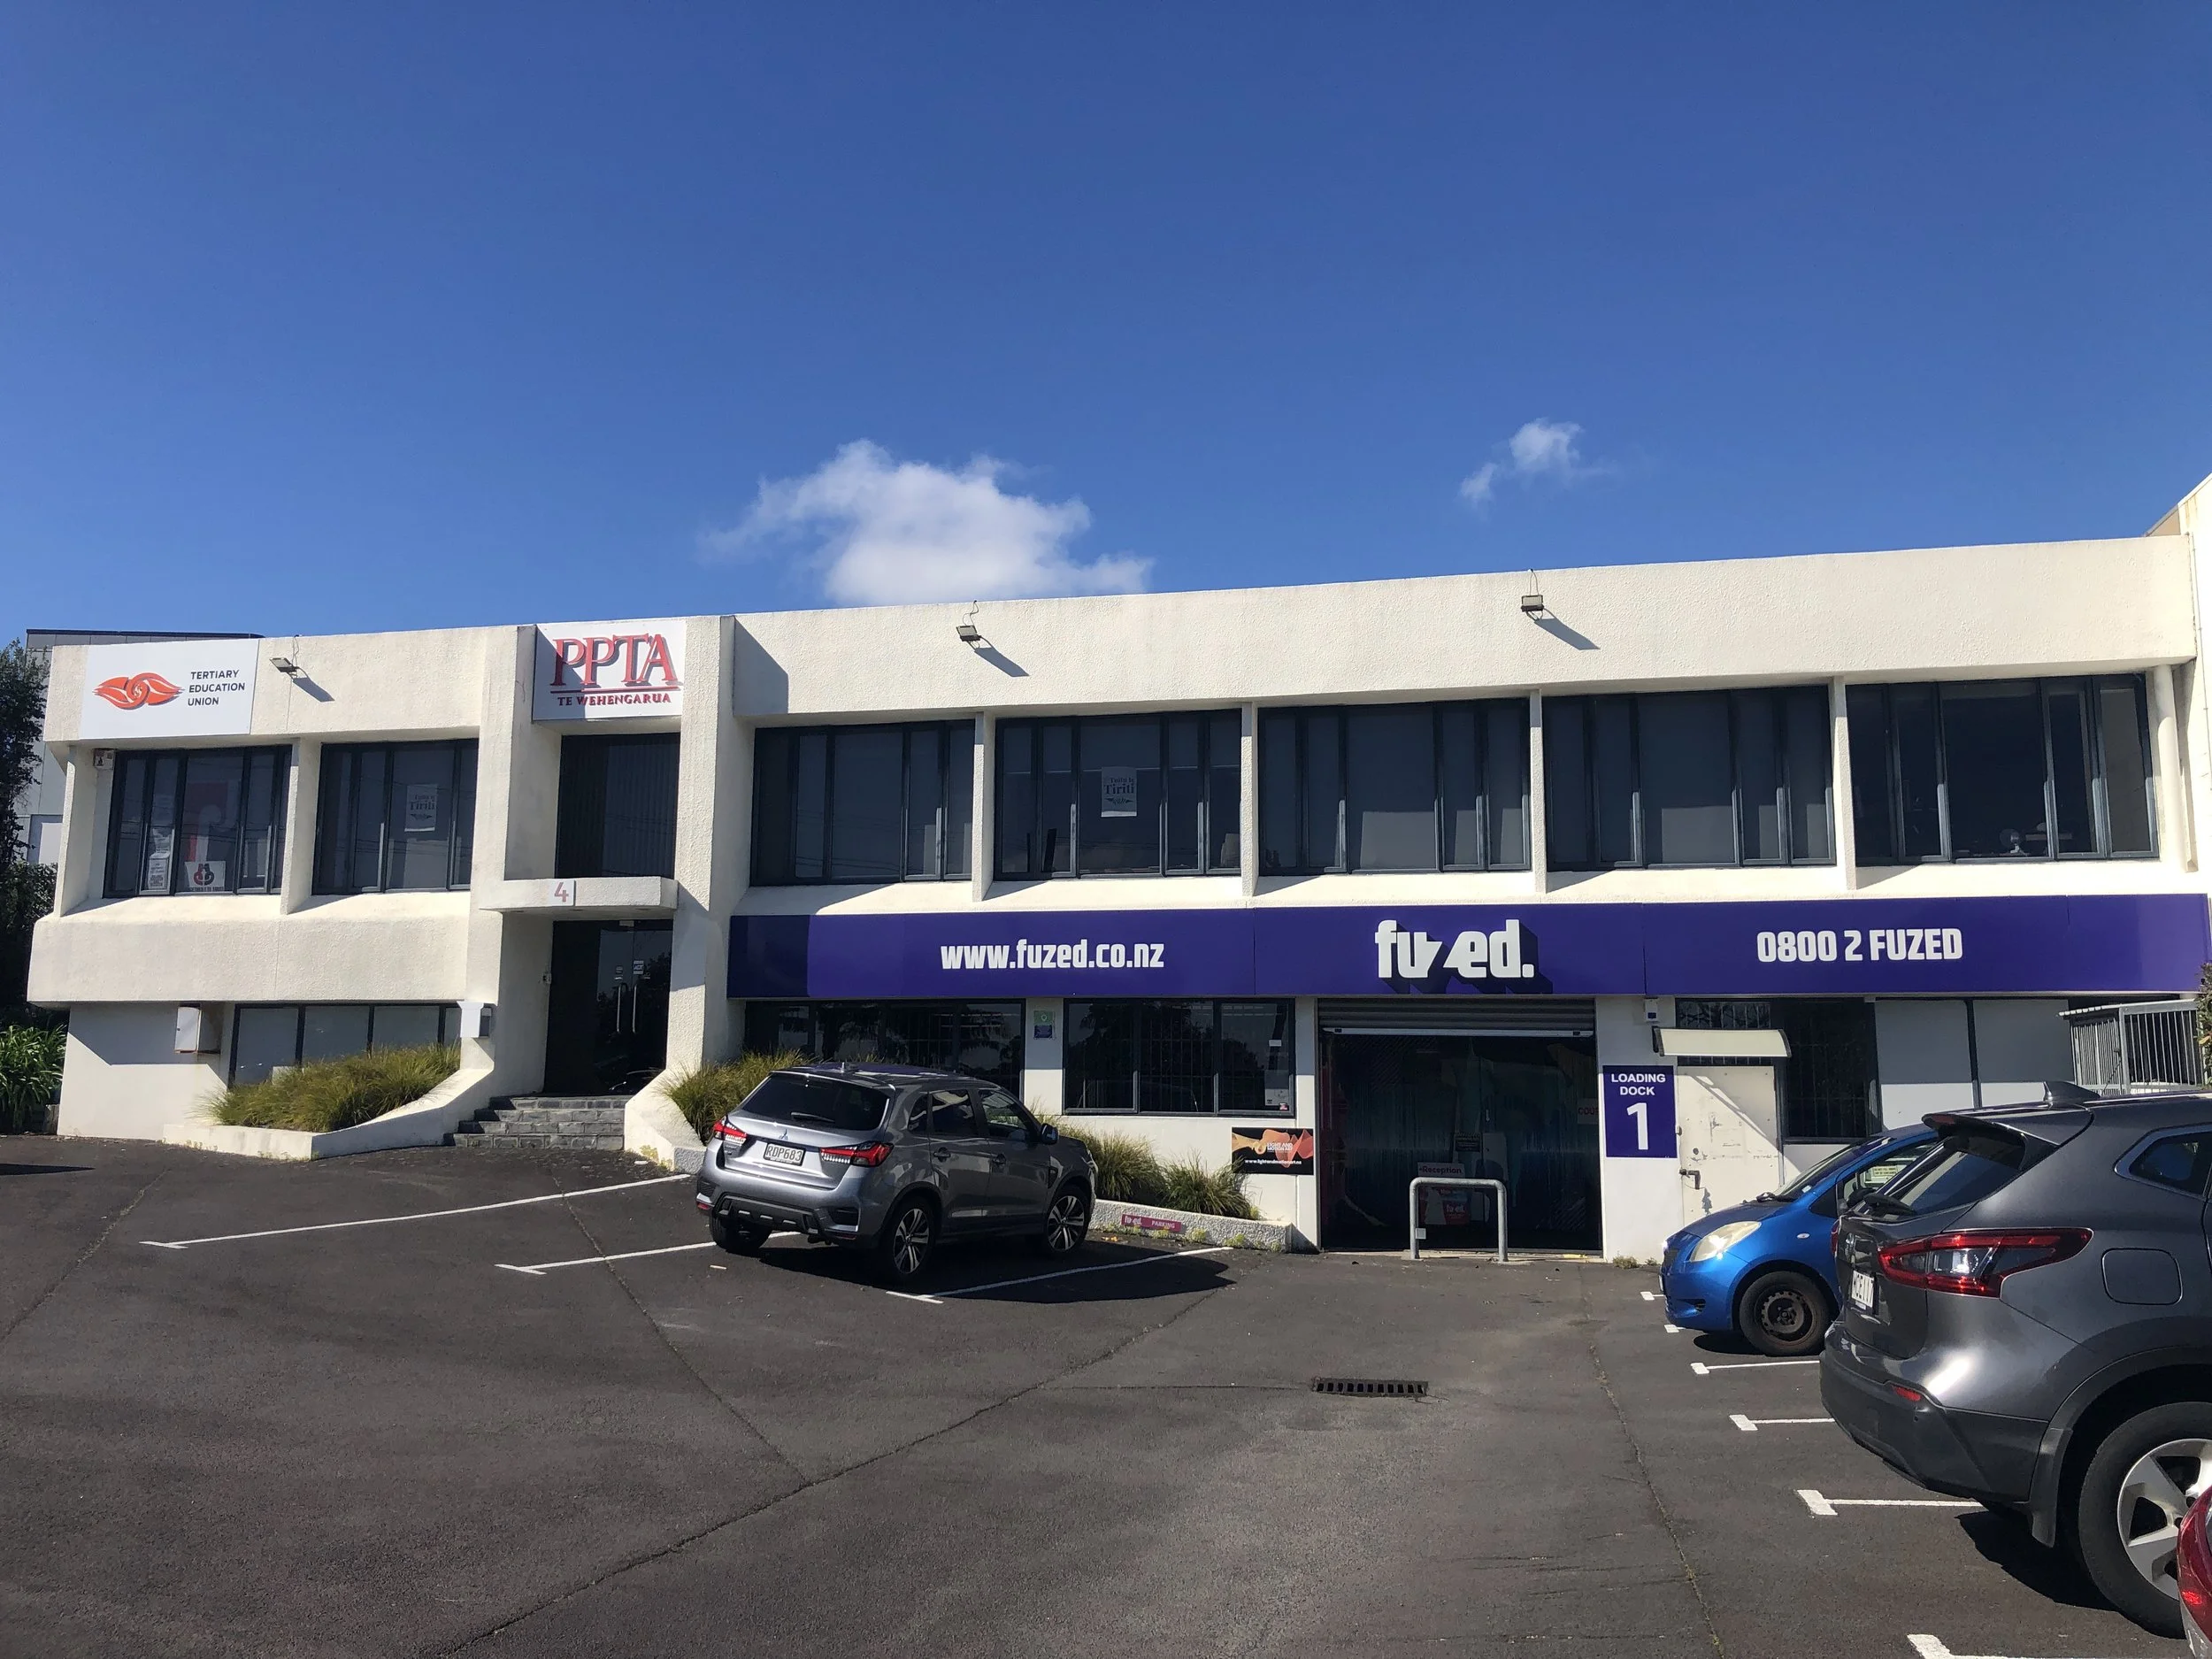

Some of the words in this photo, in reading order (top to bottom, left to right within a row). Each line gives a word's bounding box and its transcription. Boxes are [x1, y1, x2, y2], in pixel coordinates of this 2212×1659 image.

[549, 633, 680, 687] PPTA
[190, 669, 240, 680] TERTIARY
[188, 682, 246, 693] EDUCATION
[188, 697, 219, 706] UNION
[557, 696, 572, 706] TE
[577, 693, 672, 706] WEHENGARUA
[554, 881, 569, 902] 4
[1756, 931, 1838, 963] 0800
[1844, 930, 1863, 962] 2
[1869, 928, 1963, 961] FUZED
[941, 939, 1164, 970] www.fuzed.co.nz
[1611, 1073, 1666, 1083] LOADING
[1619, 1086, 1655, 1096] DOCK
[1626, 1102, 1648, 1150] 1
[765, 1146, 803, 1162] RDP683
[1422, 1165, 1463, 1175] Reception
[1152, 1220, 1176, 1229] PARKING
